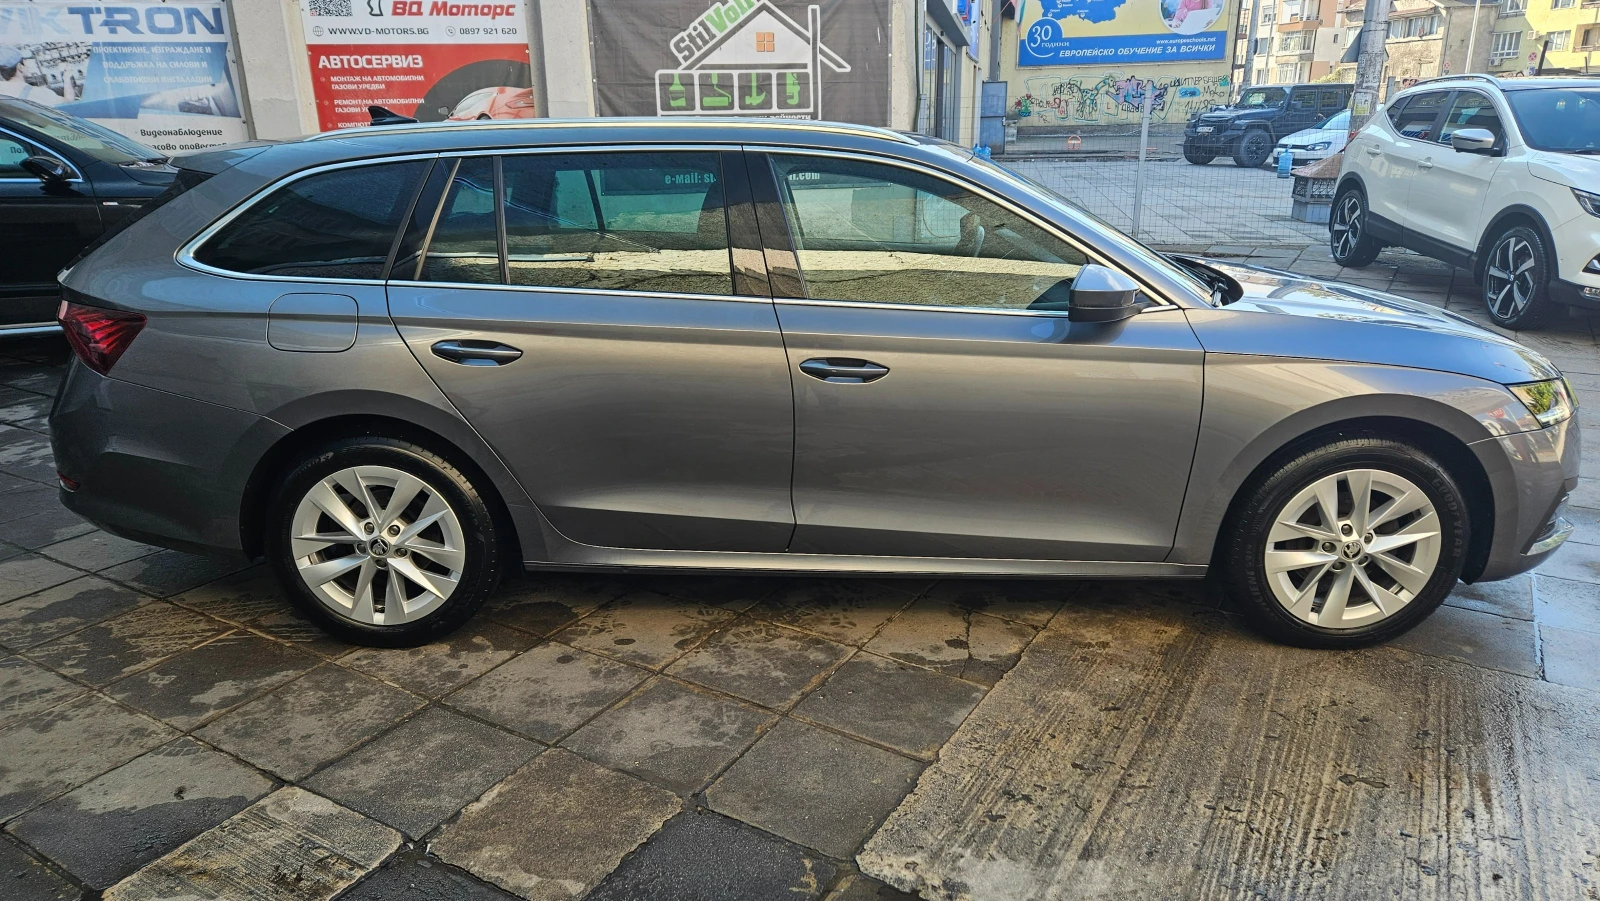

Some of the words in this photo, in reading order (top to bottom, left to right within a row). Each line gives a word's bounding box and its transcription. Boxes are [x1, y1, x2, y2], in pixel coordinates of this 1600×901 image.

[391, 1, 423, 16] ВД
[429, 1, 516, 20] Моторс
[328, 27, 430, 35] WWW.VD-MOTORS.BG
[459, 27, 480, 35] 0897
[483, 27, 498, 35] 921
[501, 27, 517, 35] 620
[1030, 25, 1052, 48] 30
[93, 46, 149, 54] ПРОЕКТИРАНЕ,
[151, 46, 204, 54] ИЗГРАЖДАНЕ
[1059, 48, 1115, 57] ЕВРОПЕЙСКО
[1118, 46, 1163, 55] ОБУЧЕНИЕ
[1165, 45, 1177, 53] ЗА
[1180, 44, 1216, 52] ВСИЧКИ
[103, 61, 154, 69] ПОДДРЪЖКА
[318, 55, 423, 68] АВТОСЕРВИЗ
[140, 128, 223, 138] Видеонаблюдение
[152, 143, 177, 151] асово
